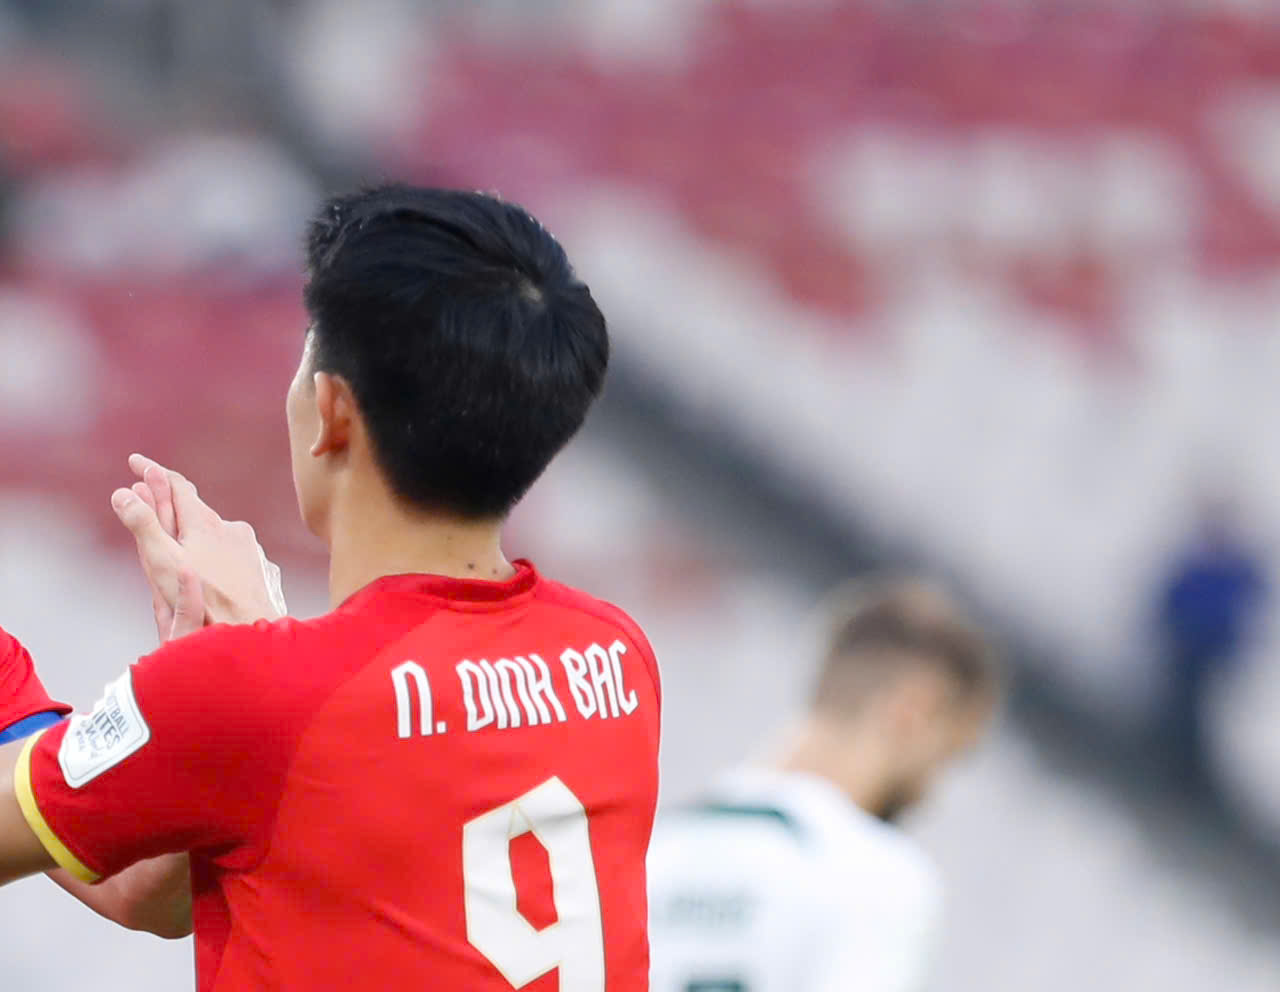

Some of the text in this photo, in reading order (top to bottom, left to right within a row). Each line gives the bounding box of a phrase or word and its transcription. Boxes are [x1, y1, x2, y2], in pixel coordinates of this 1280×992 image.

[391, 639, 639, 739] N. DINH BAC
